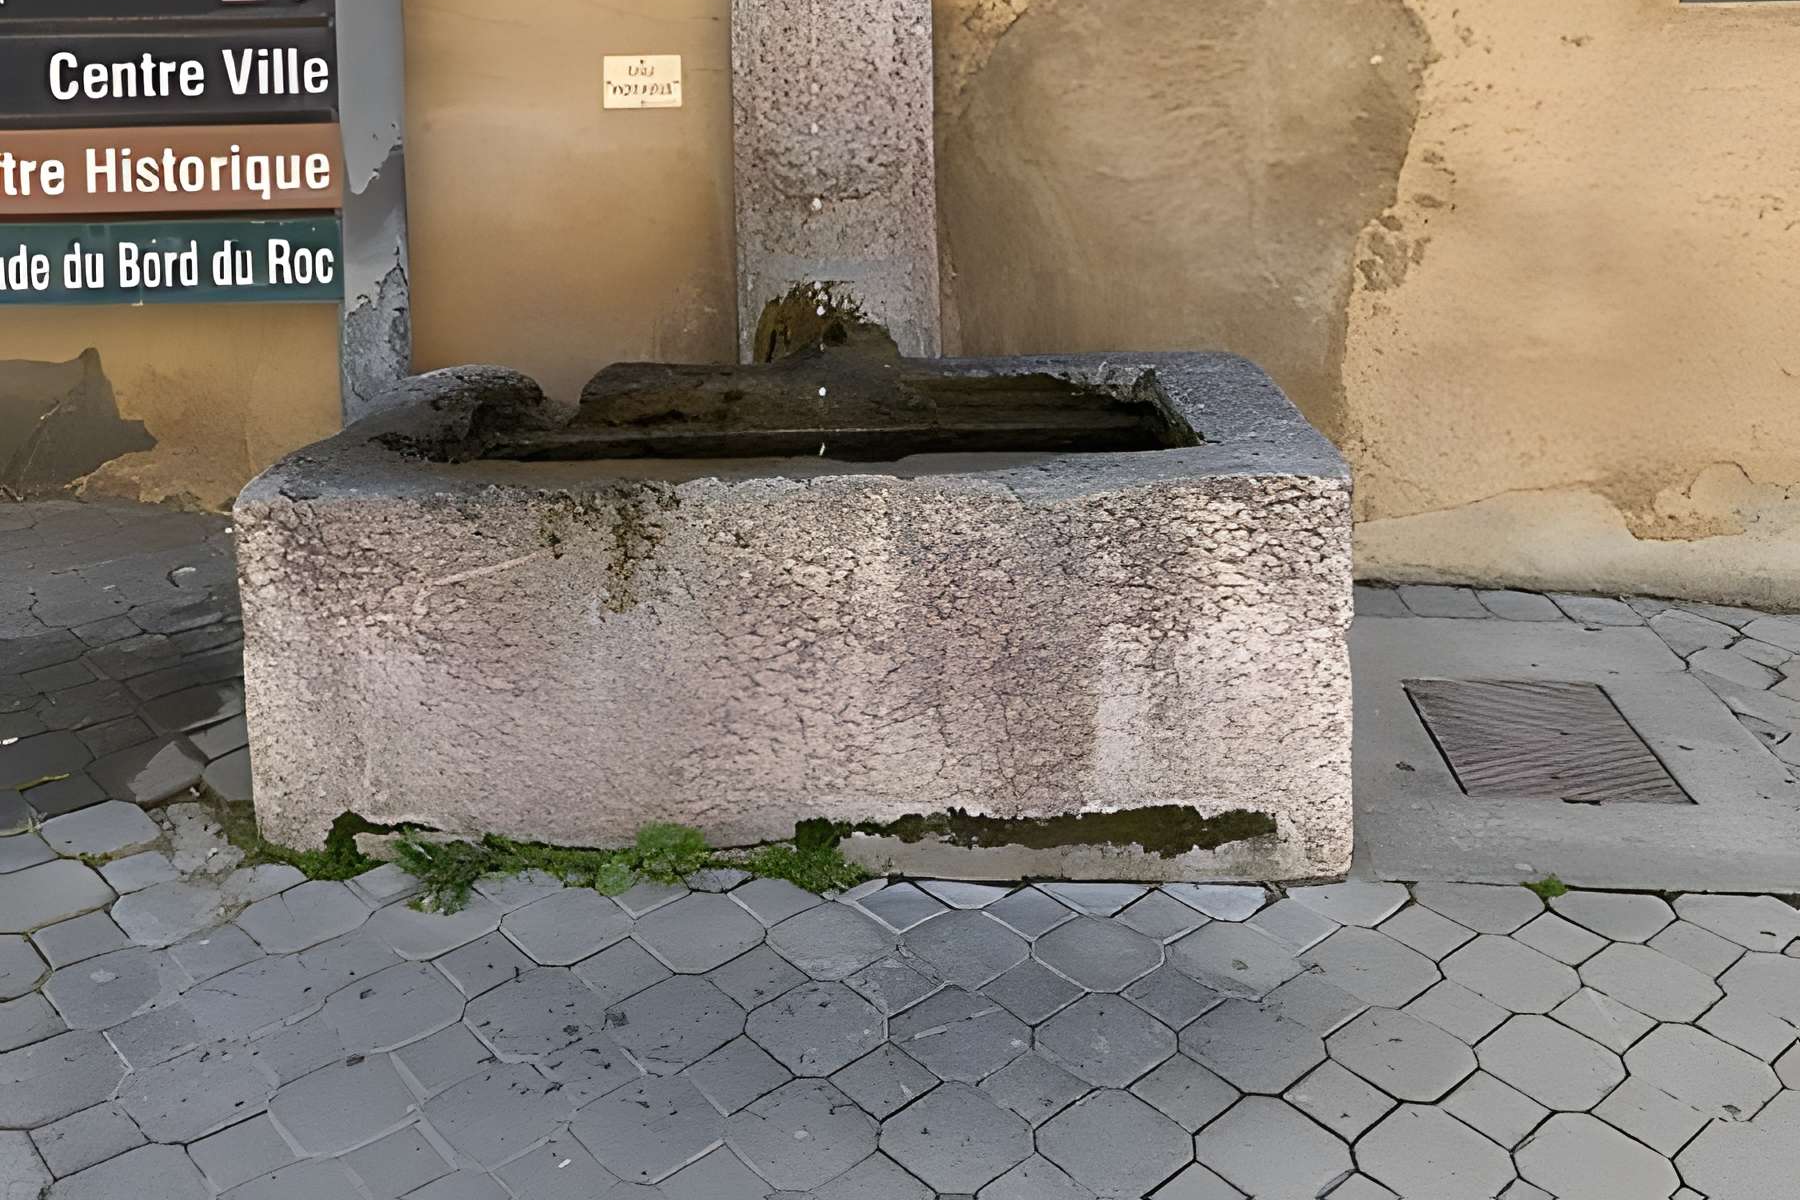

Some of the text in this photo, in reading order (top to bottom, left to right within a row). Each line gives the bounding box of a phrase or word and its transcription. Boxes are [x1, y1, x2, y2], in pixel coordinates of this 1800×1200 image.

[49, 48, 329, 100] Centre Ville
[85, 144, 331, 200] Historique
[63, 242, 104, 289] du
[118, 242, 199, 289] Bord
[212, 240, 254, 286] du
[267, 238, 334, 285] Roc
